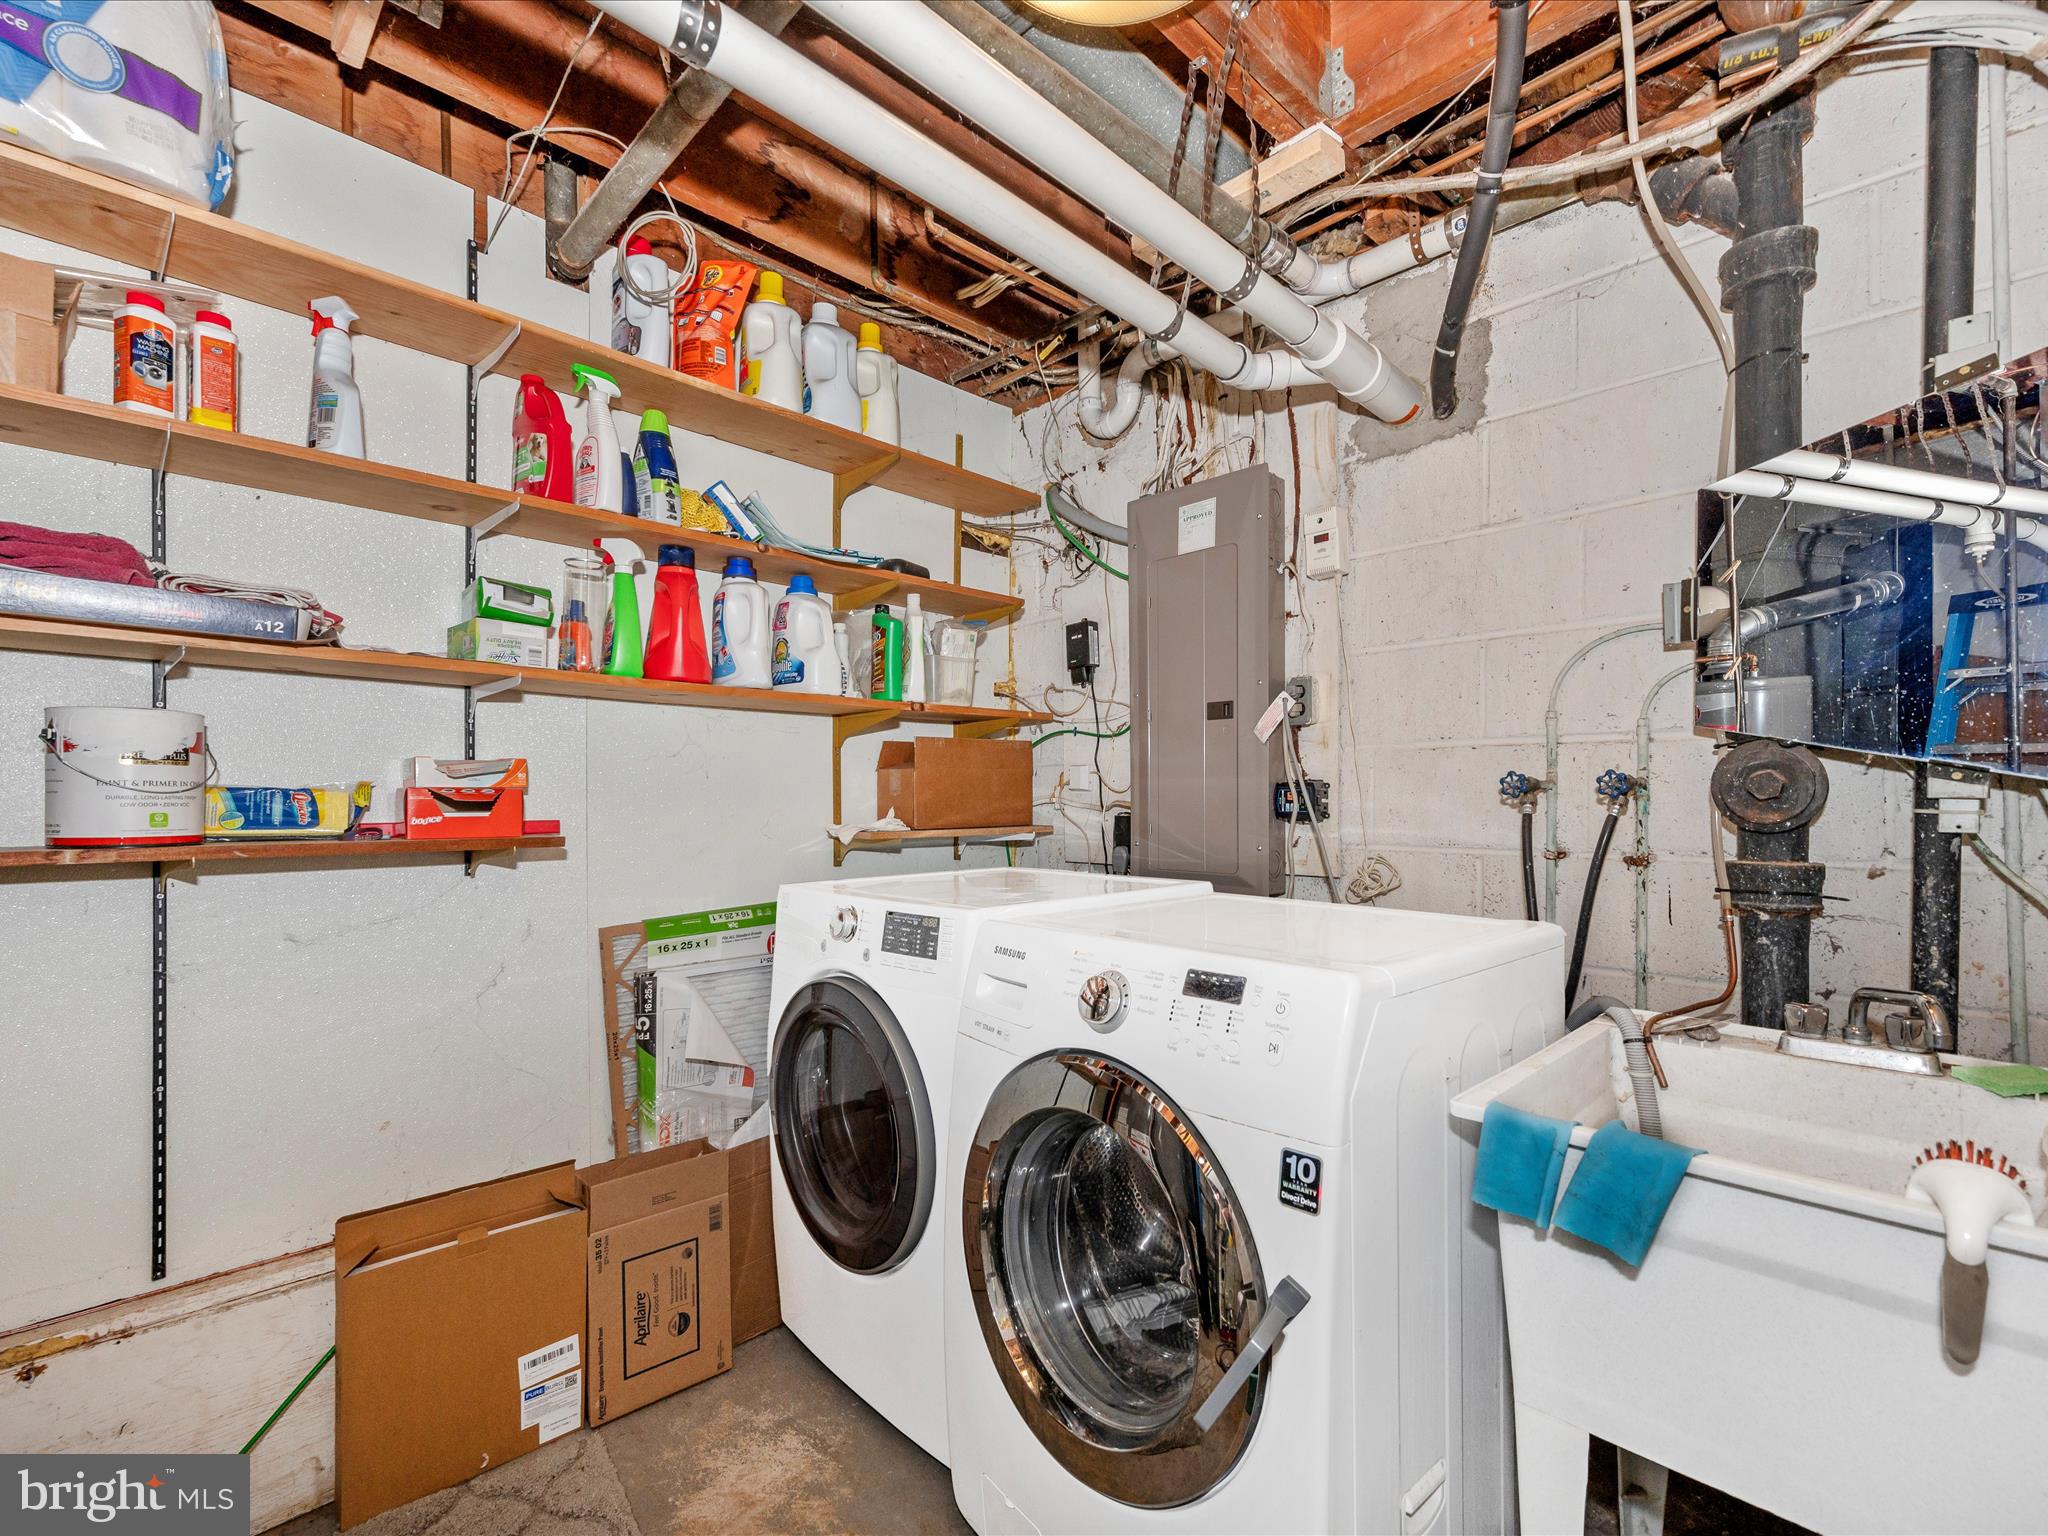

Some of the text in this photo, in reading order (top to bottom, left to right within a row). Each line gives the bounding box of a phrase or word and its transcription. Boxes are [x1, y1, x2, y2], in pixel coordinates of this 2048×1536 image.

[96, 779, 128, 787] PAINT
[410, 815, 442, 826] bounce
[657, 943, 670, 954] 16
[680, 941, 694, 951] 25
[994, 945, 1026, 960] SAMSUNG
[637, 1016, 651, 1031] 5
[1286, 1154, 1317, 1184] 10
[1282, 1180, 1318, 1197] WARRANTY
[1281, 1190, 1317, 1209] Direct Drive
[594, 1238, 602, 1249] 02
[634, 1291, 650, 1346] Aprilaire
[525, 1388, 544, 1400] PURE
